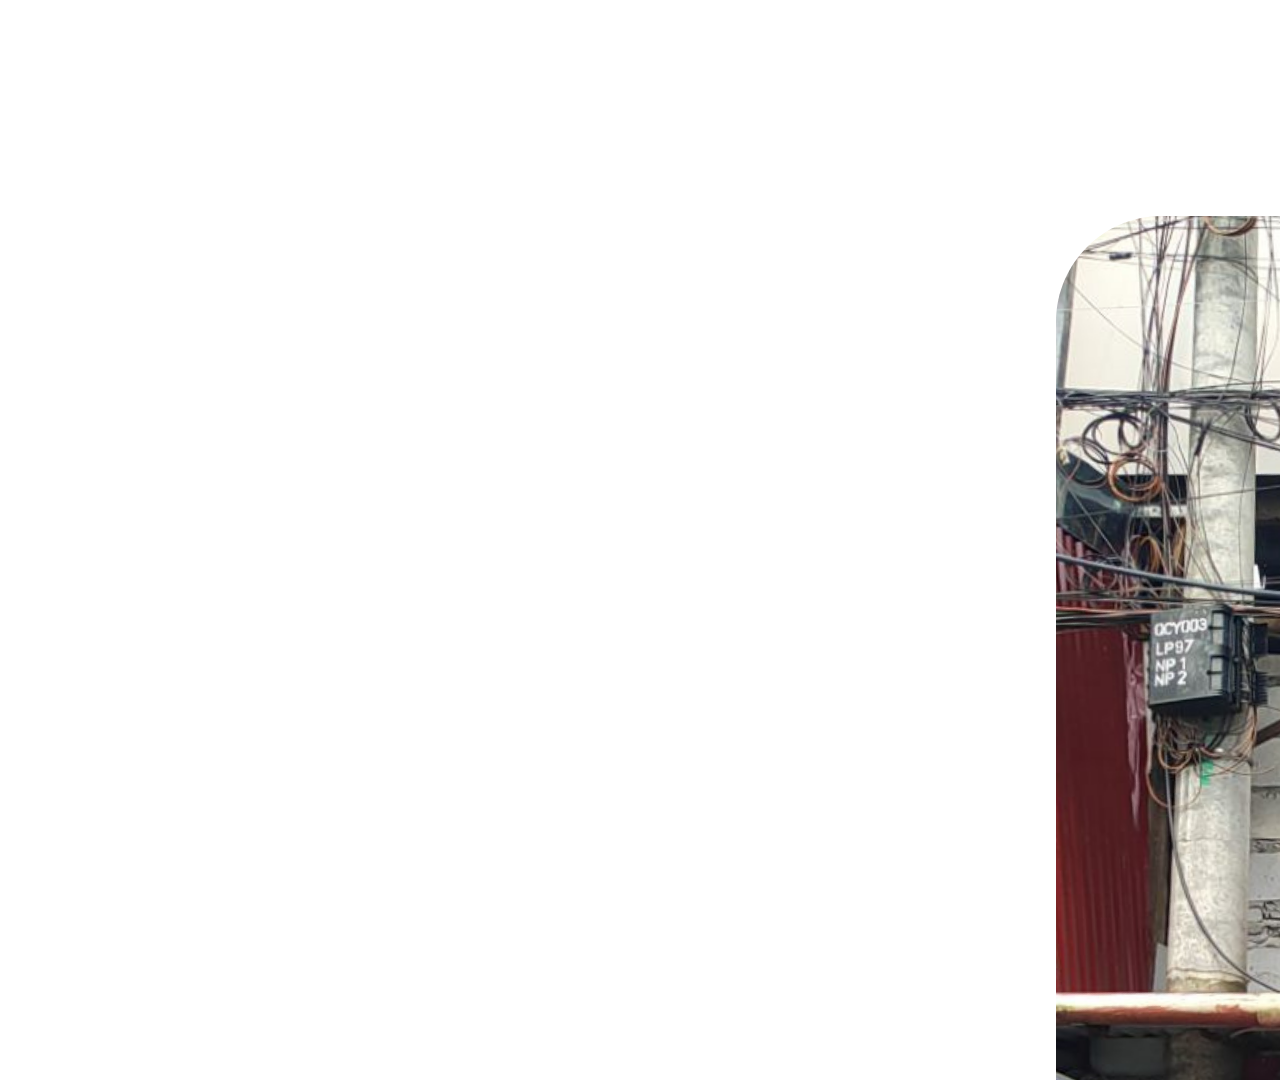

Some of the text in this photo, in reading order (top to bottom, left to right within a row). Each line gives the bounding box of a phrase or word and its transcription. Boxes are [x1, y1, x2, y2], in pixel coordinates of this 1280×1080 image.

[1155, 656, 1186, 673] NP 1
[1154, 671, 1188, 687] NP 2
